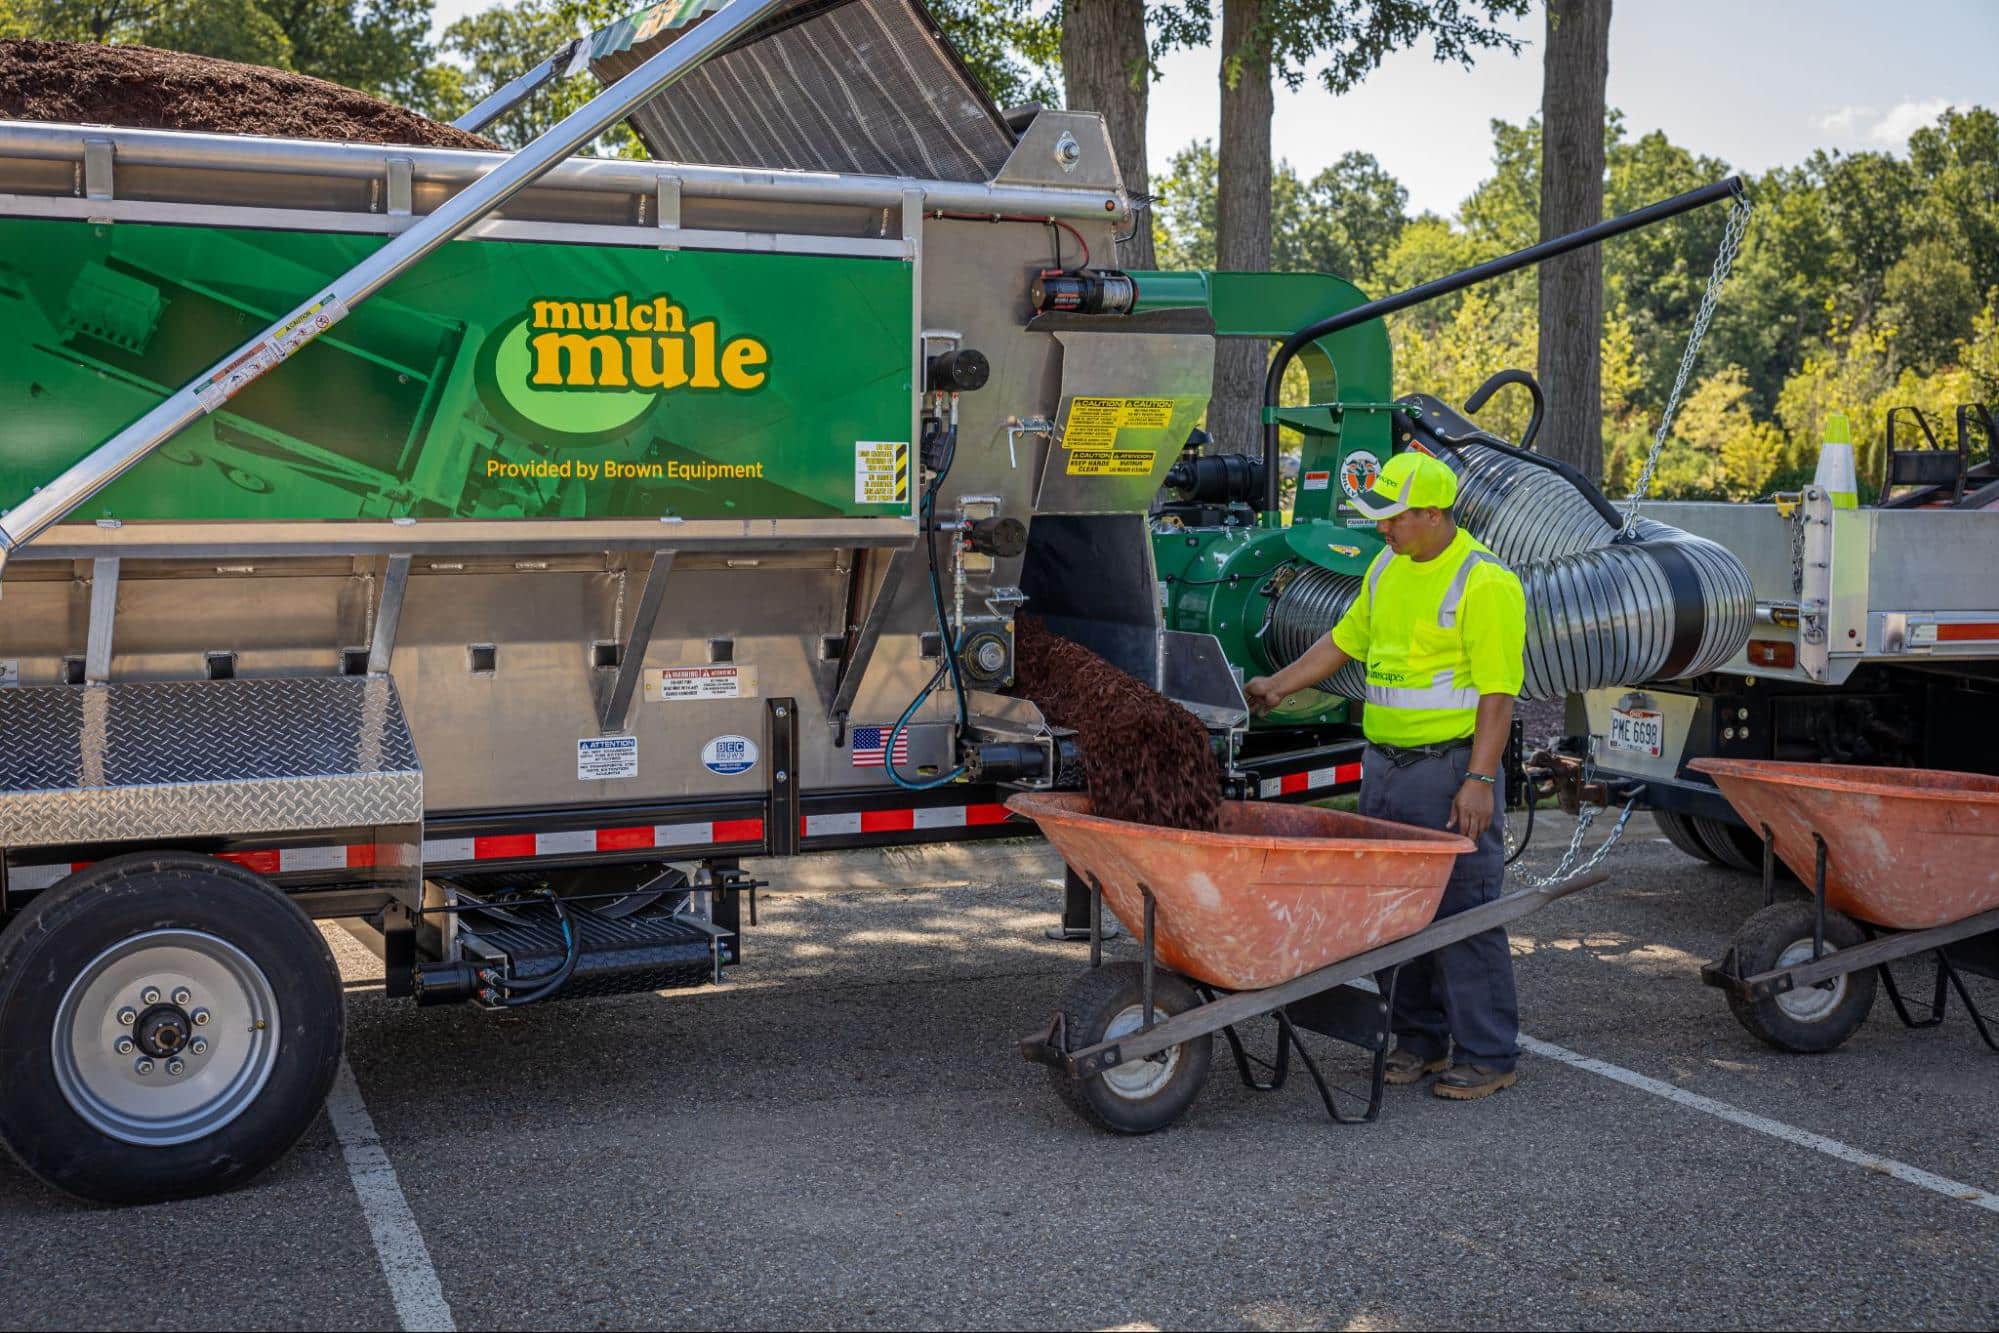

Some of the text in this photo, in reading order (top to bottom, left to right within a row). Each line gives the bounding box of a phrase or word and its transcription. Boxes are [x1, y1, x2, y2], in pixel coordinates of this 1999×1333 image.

[532, 295, 686, 333] mulch
[532, 321, 768, 390] mule
[1082, 400, 1121, 408] CAUTION
[1134, 400, 1172, 408] CAUTION
[487, 460, 763, 481] Provided by Brown Equipment
[1341, 473, 1358, 497] BILLY
[1612, 718, 1658, 745] PME 6698
[590, 740, 634, 748] ATTENTION
[717, 741, 744, 752] BEC
